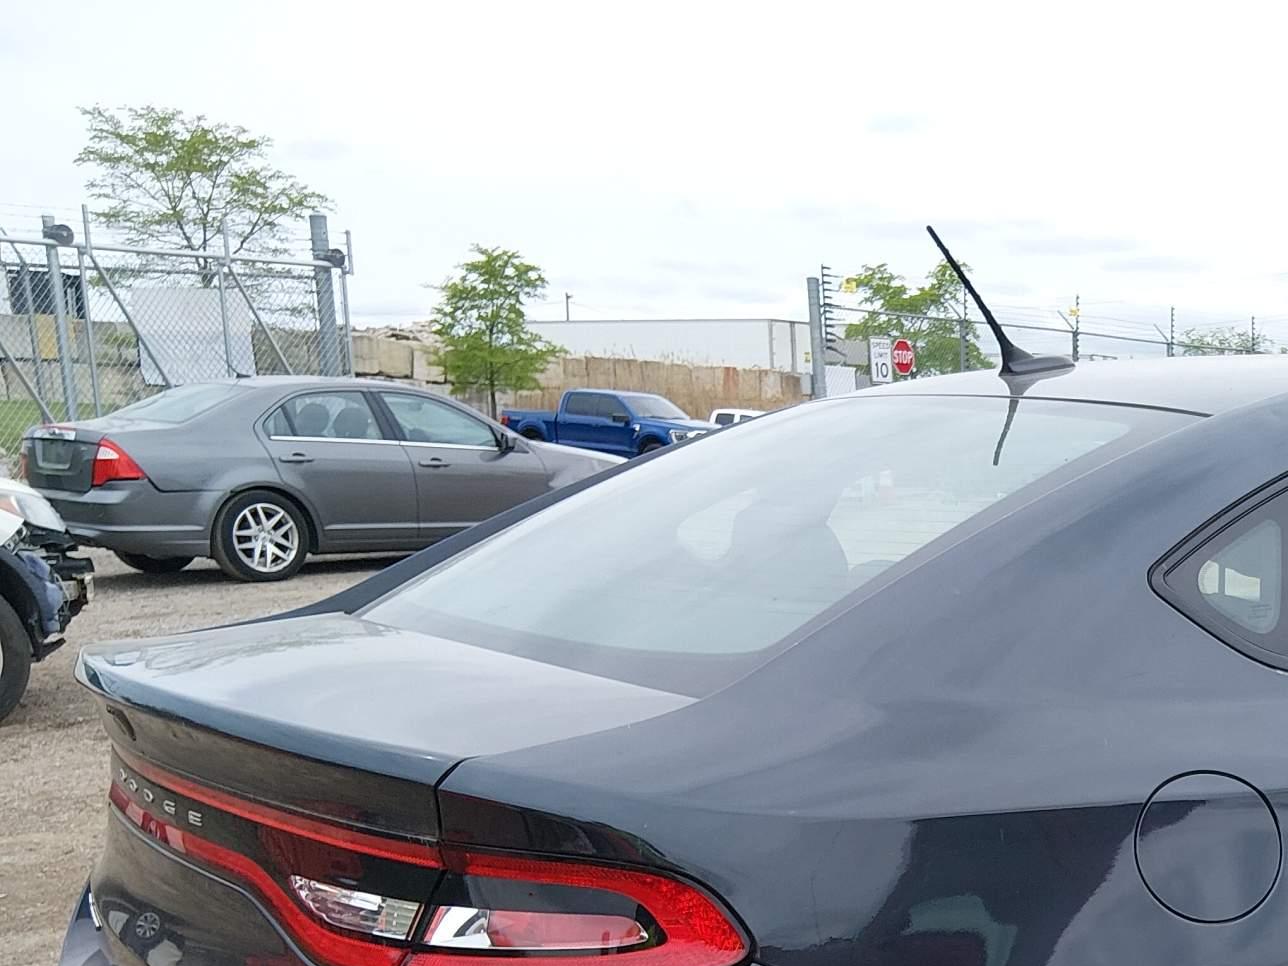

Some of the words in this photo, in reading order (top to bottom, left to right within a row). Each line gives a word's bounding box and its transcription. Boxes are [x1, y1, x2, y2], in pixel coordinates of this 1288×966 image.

[893, 350, 913, 364] STOP
[875, 362, 889, 378] 10
[119, 768, 203, 827] DODGE
